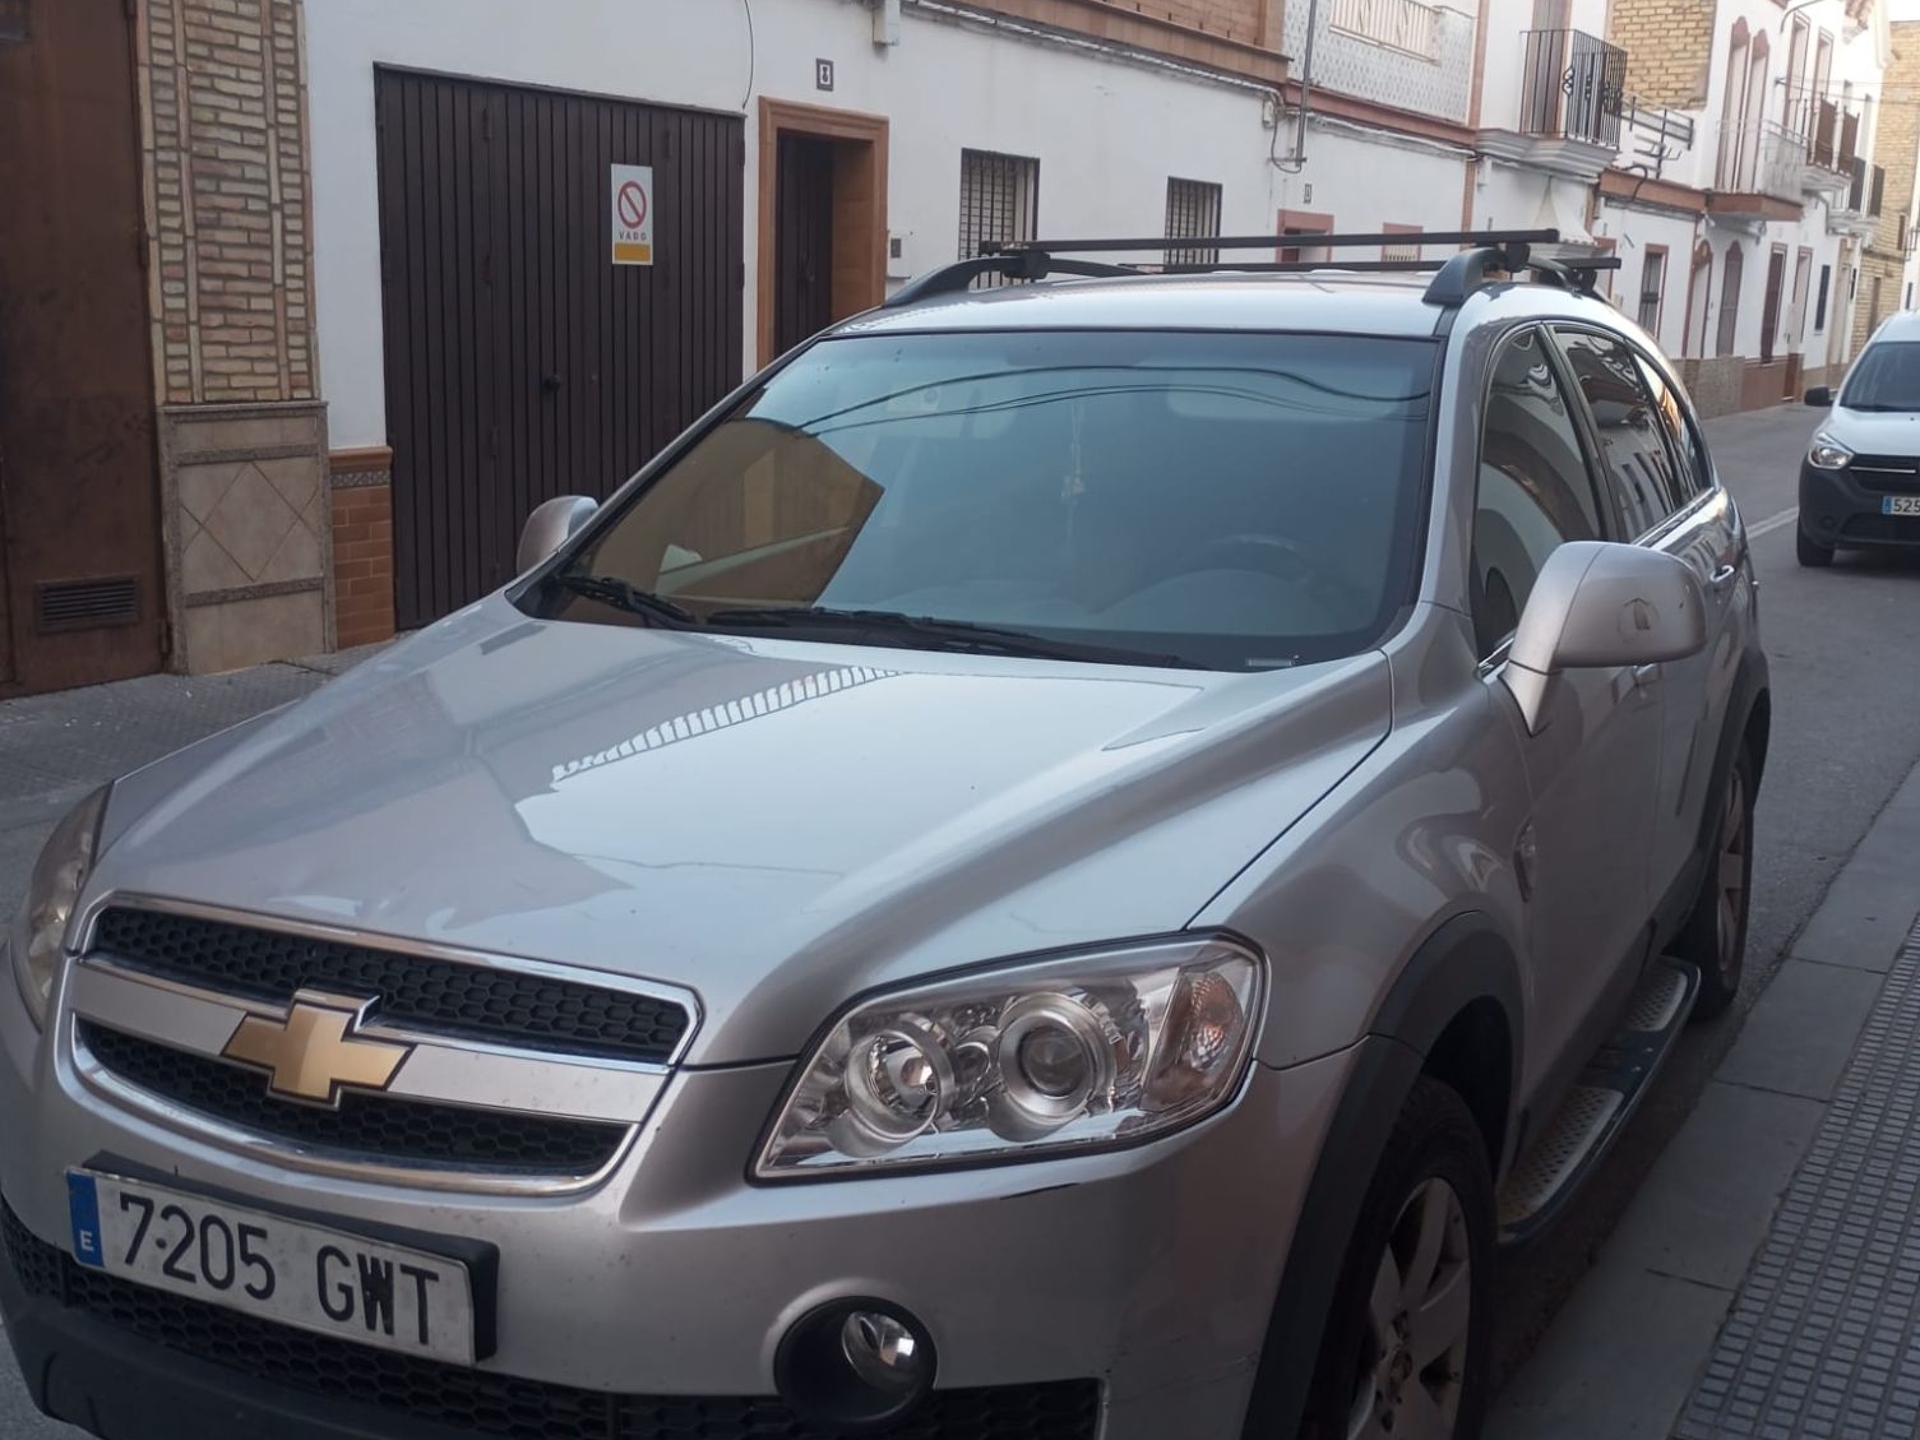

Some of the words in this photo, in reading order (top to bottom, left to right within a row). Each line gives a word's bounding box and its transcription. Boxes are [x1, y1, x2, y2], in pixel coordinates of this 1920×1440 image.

[619, 230, 648, 242] VADO
[1894, 498, 1920, 513] 525
[80, 1230, 93, 1251] E
[119, 1191, 276, 1300] 7205
[316, 1244, 440, 1346] GWT
